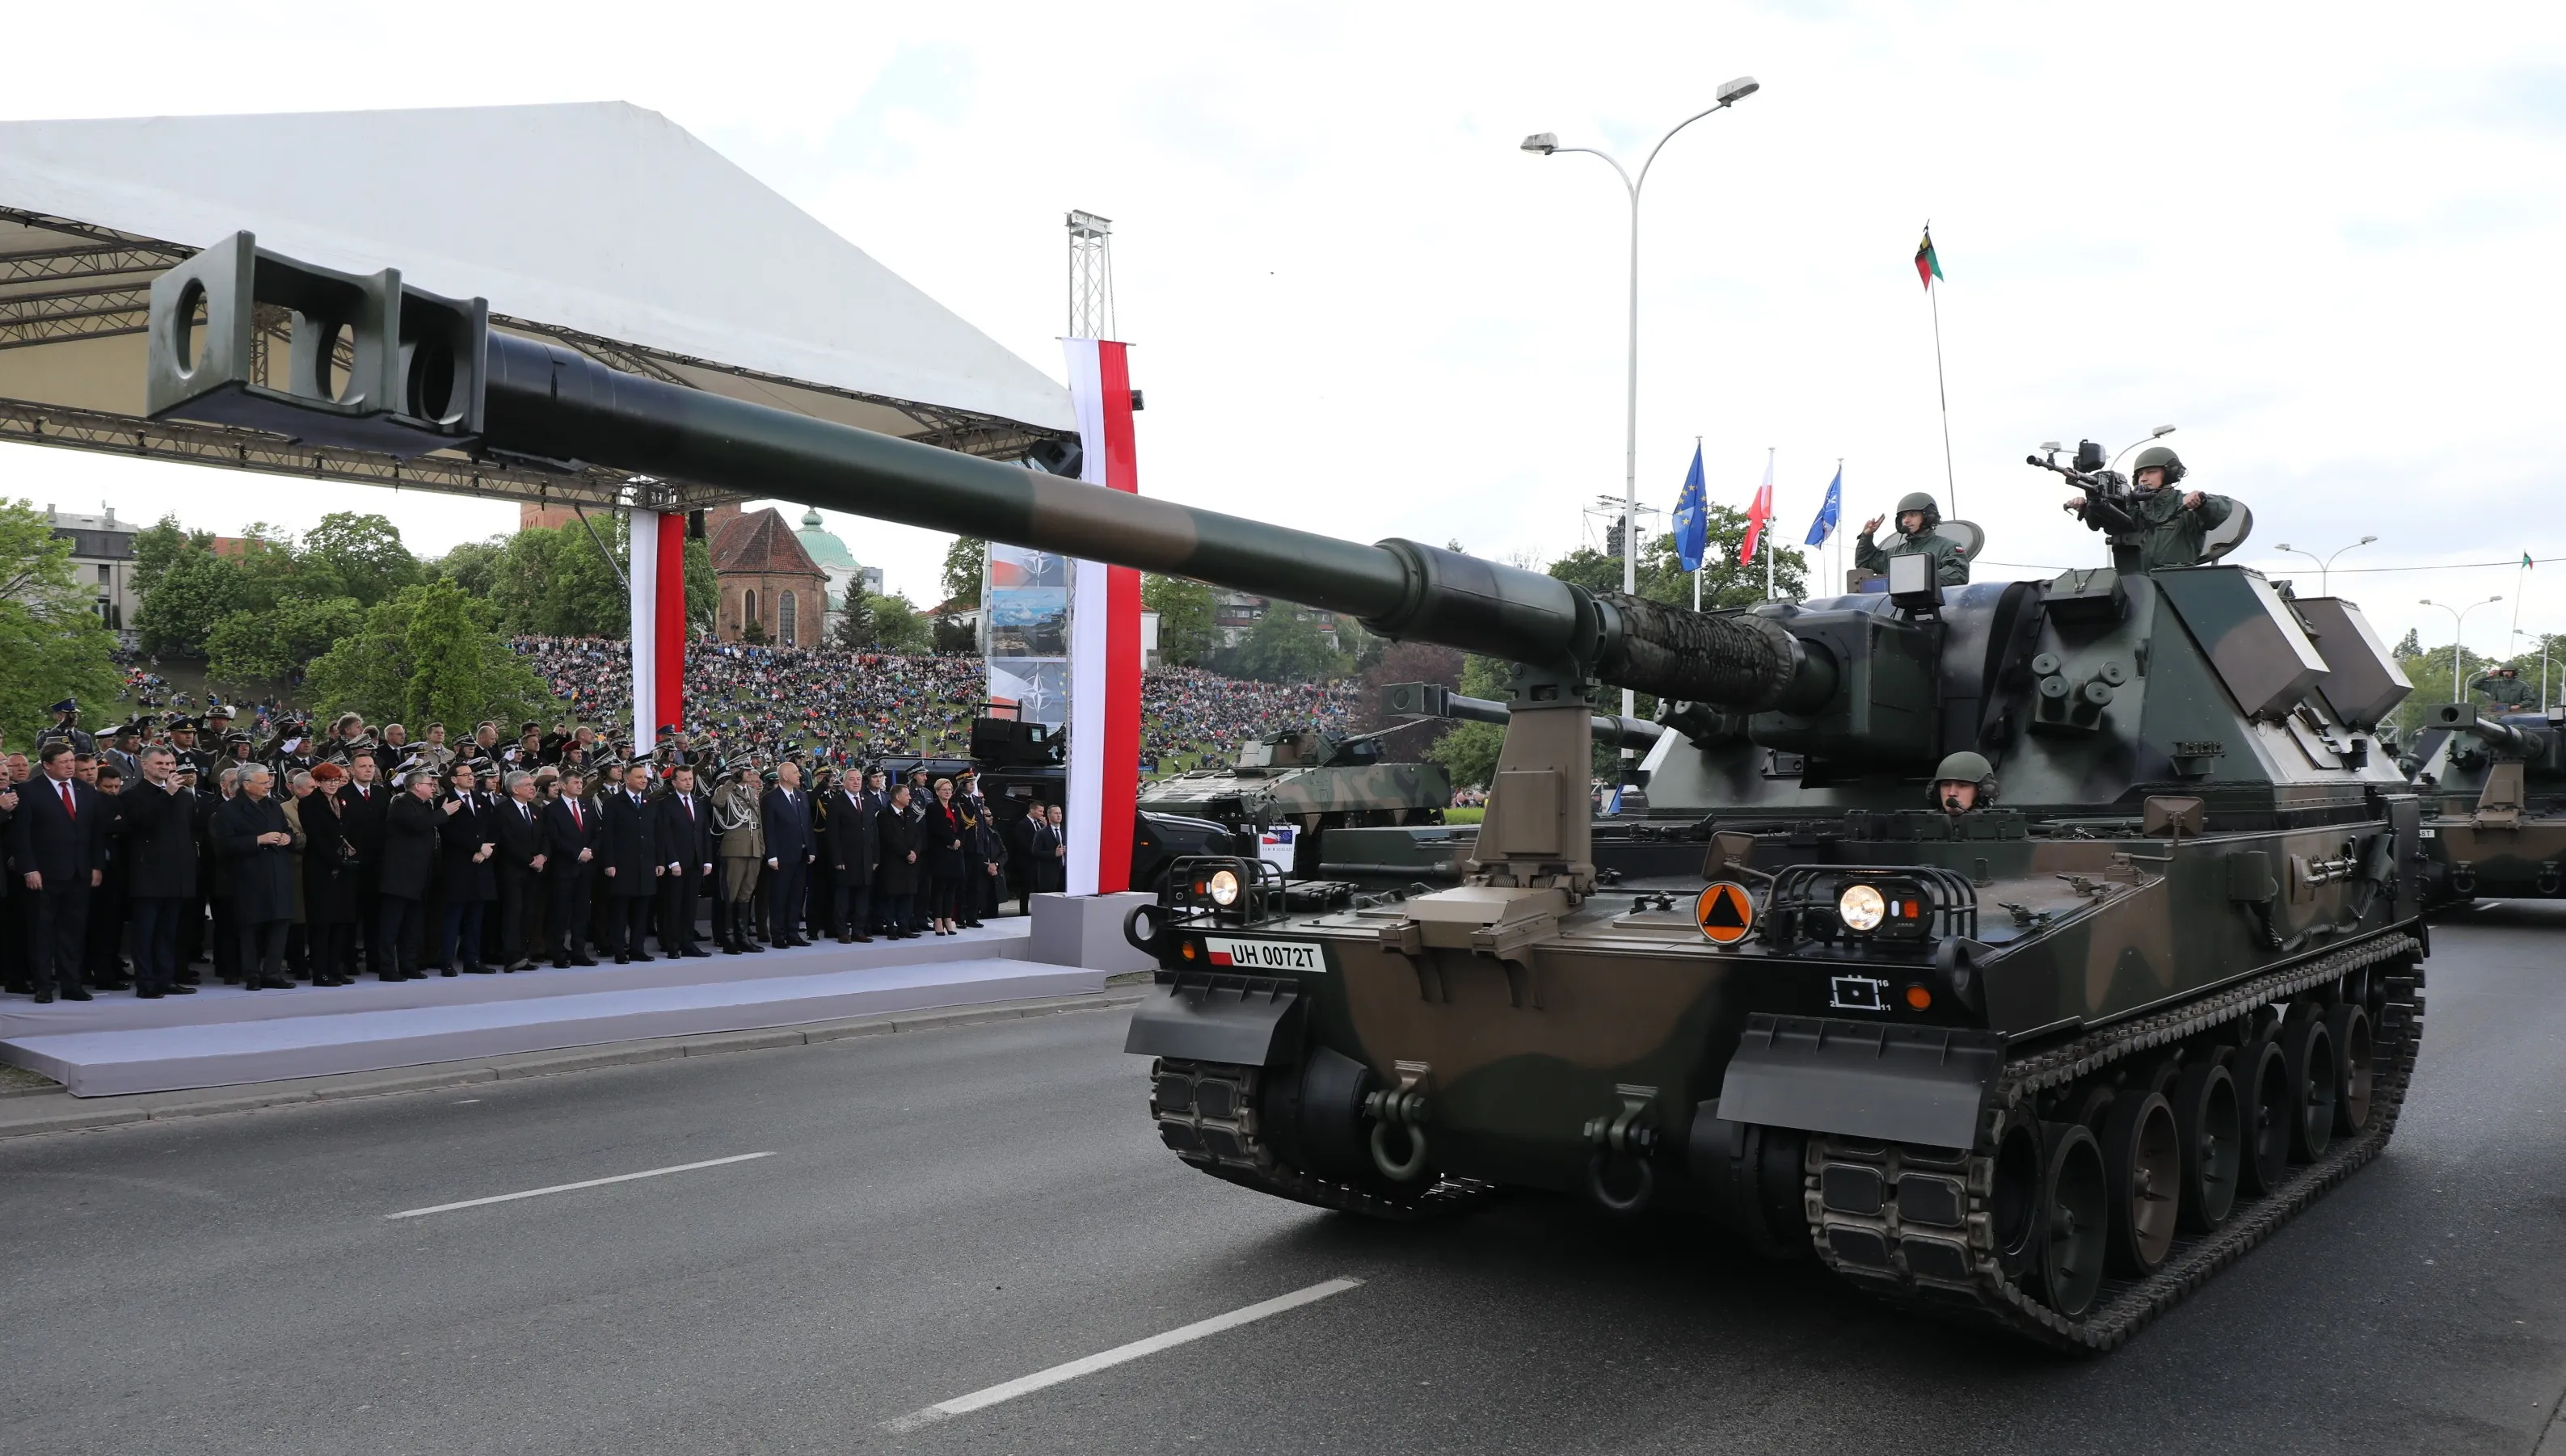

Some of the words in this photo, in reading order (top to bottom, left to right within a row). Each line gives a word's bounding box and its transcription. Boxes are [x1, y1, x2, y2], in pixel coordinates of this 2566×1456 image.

[1231, 944, 1258, 965] UH
[1262, 945, 1314, 968] 0072T
[1877, 979, 1890, 987] 16
